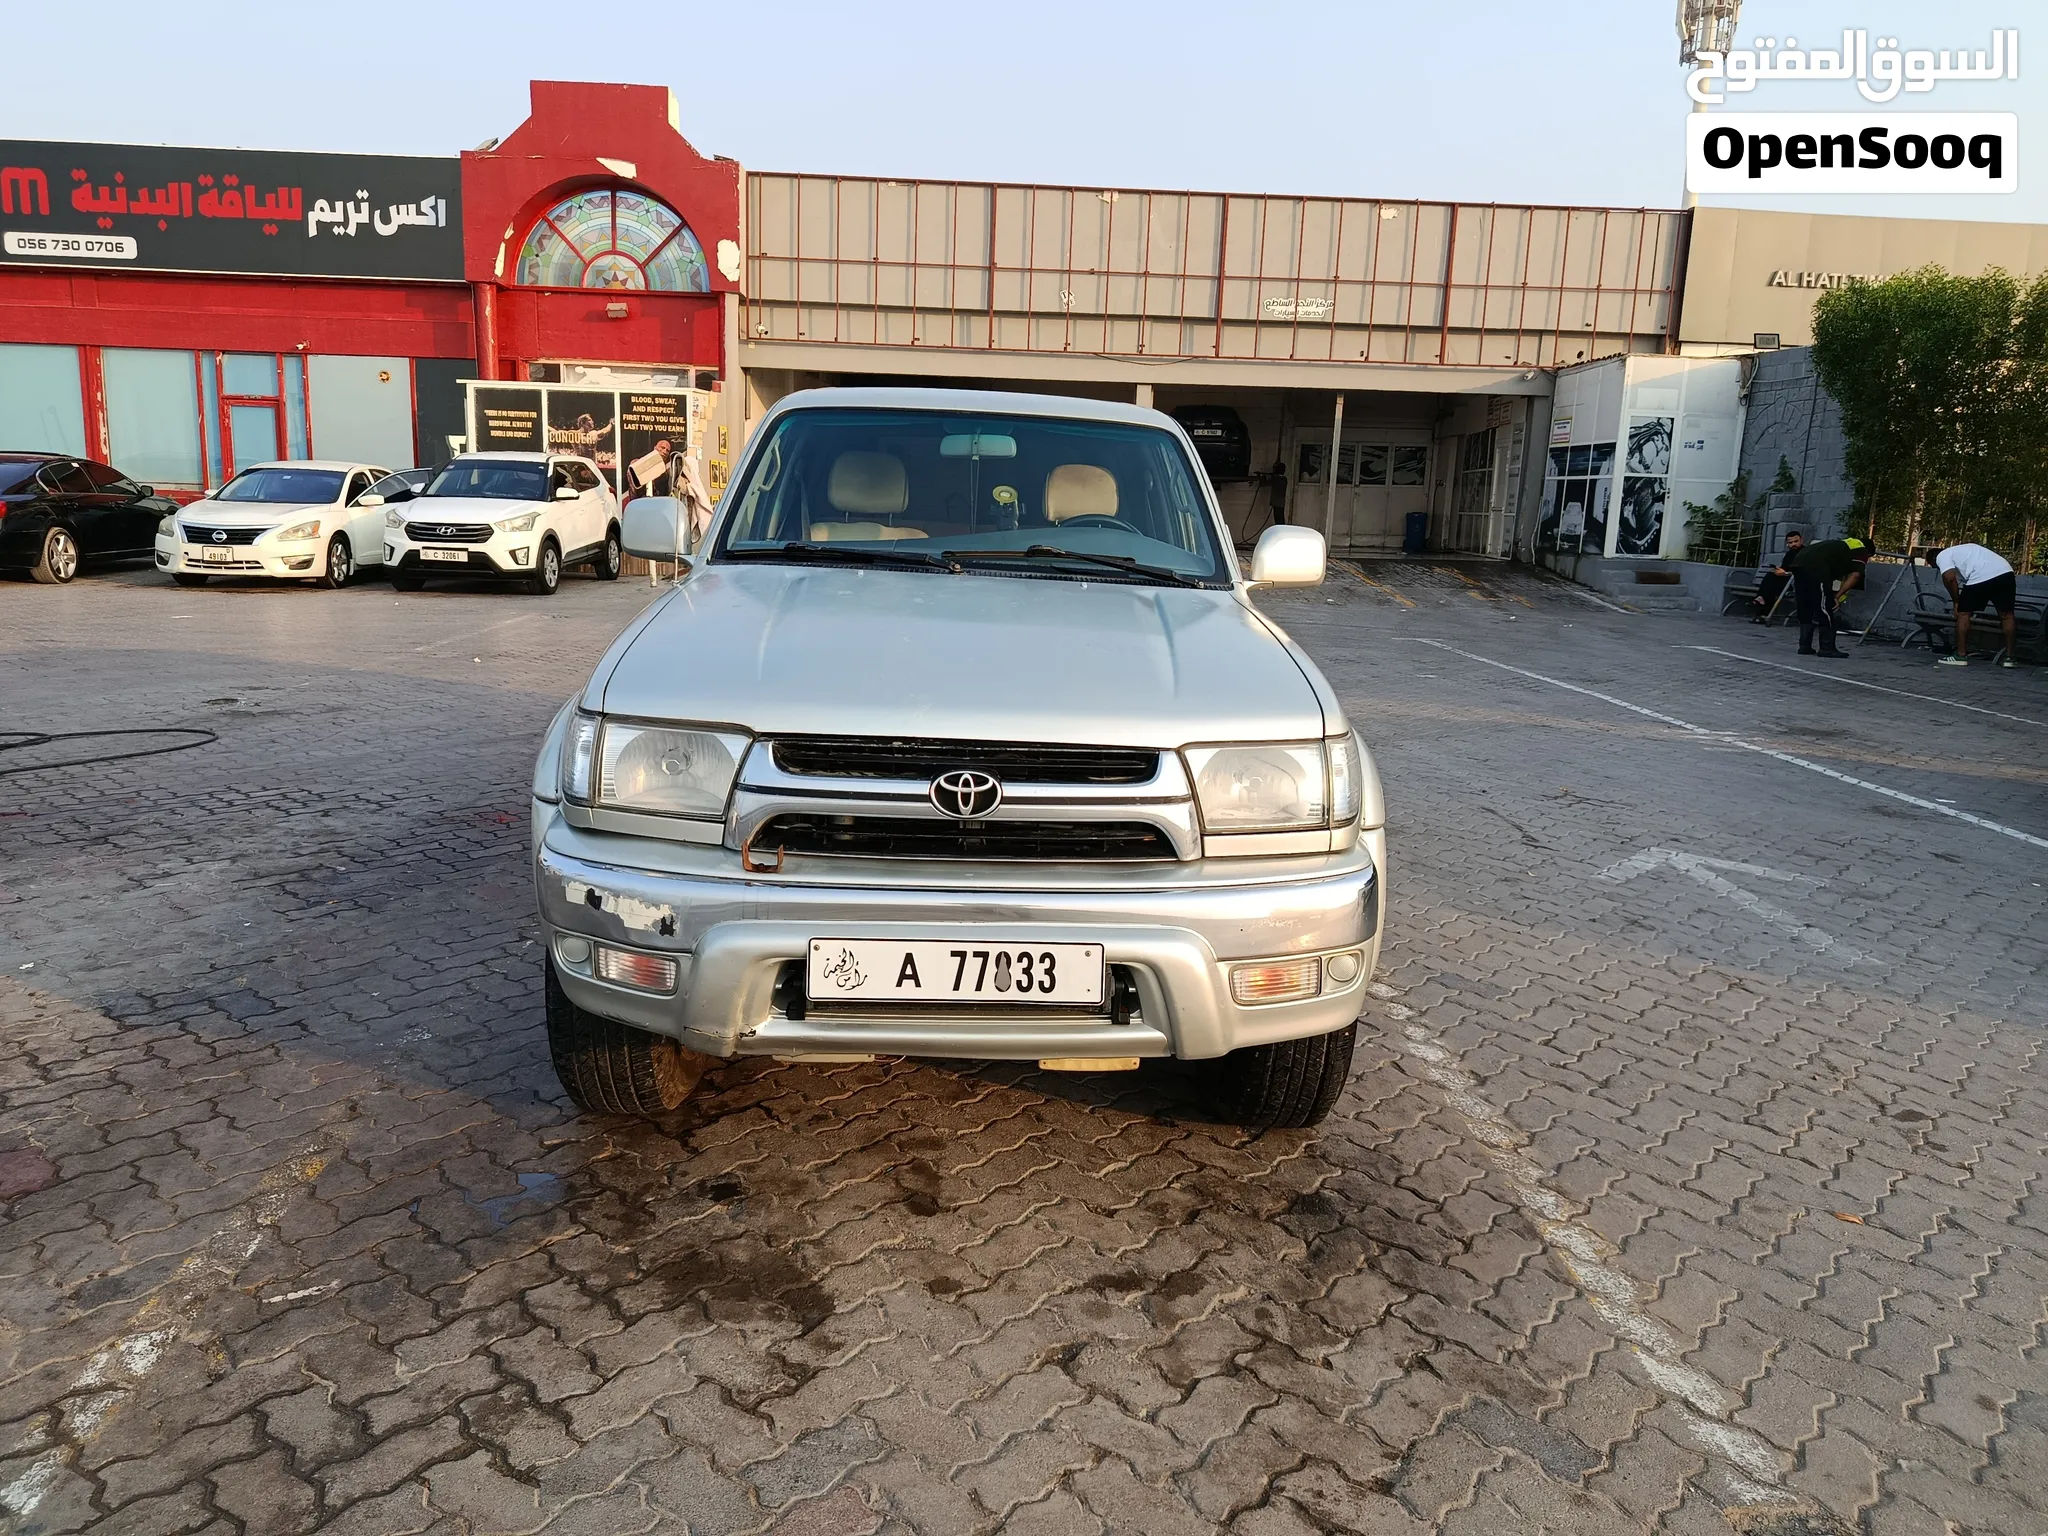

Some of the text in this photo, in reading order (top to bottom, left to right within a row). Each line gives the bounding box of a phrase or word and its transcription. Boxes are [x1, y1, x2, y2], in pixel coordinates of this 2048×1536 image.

[71, 168, 446, 238] اكس تريم للياقة البدنية
[17, 238, 125, 253] 056 730 0706
[1771, 269, 1799, 287] AL
[631, 396, 677, 406] BLOOD, SWEAT,
[647, 406, 676, 414] RESPECT.
[622, 413, 640, 421] FIRST
[640, 414, 655, 422] TWO
[639, 423, 654, 431] TWO
[668, 425, 685, 433] EARN
[549, 431, 596, 445] CONQUER.
[895, 952, 922, 988] A
